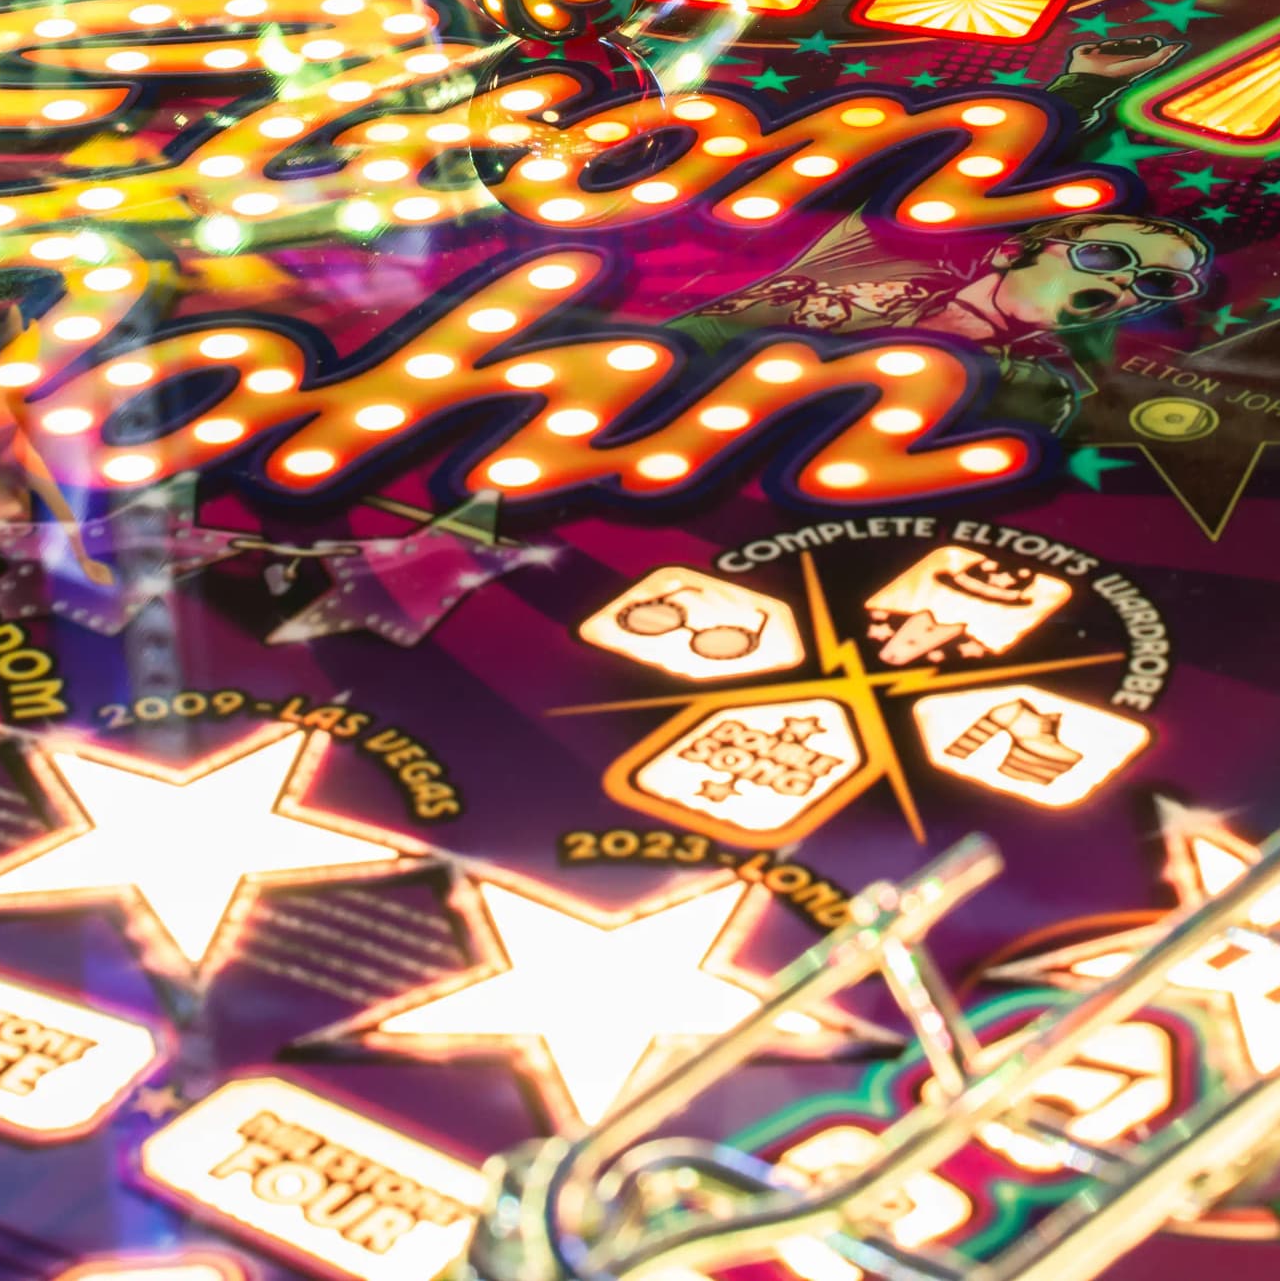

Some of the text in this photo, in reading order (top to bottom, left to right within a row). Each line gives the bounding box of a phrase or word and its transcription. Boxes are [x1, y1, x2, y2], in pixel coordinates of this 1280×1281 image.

[1120, 354, 1221, 396] ELTON
[717, 516, 1170, 711] COMPLETE ELTON'S WARDROBE
[98, 690, 246, 730] 2009
[279, 696, 371, 737] LAS
[363, 728, 461, 819] VEGAS
[677, 736, 818, 797] SONG
[563, 829, 711, 863] 2023
[737, 853, 853, 928] LOND
[208, 1143, 418, 1255] FOUR
